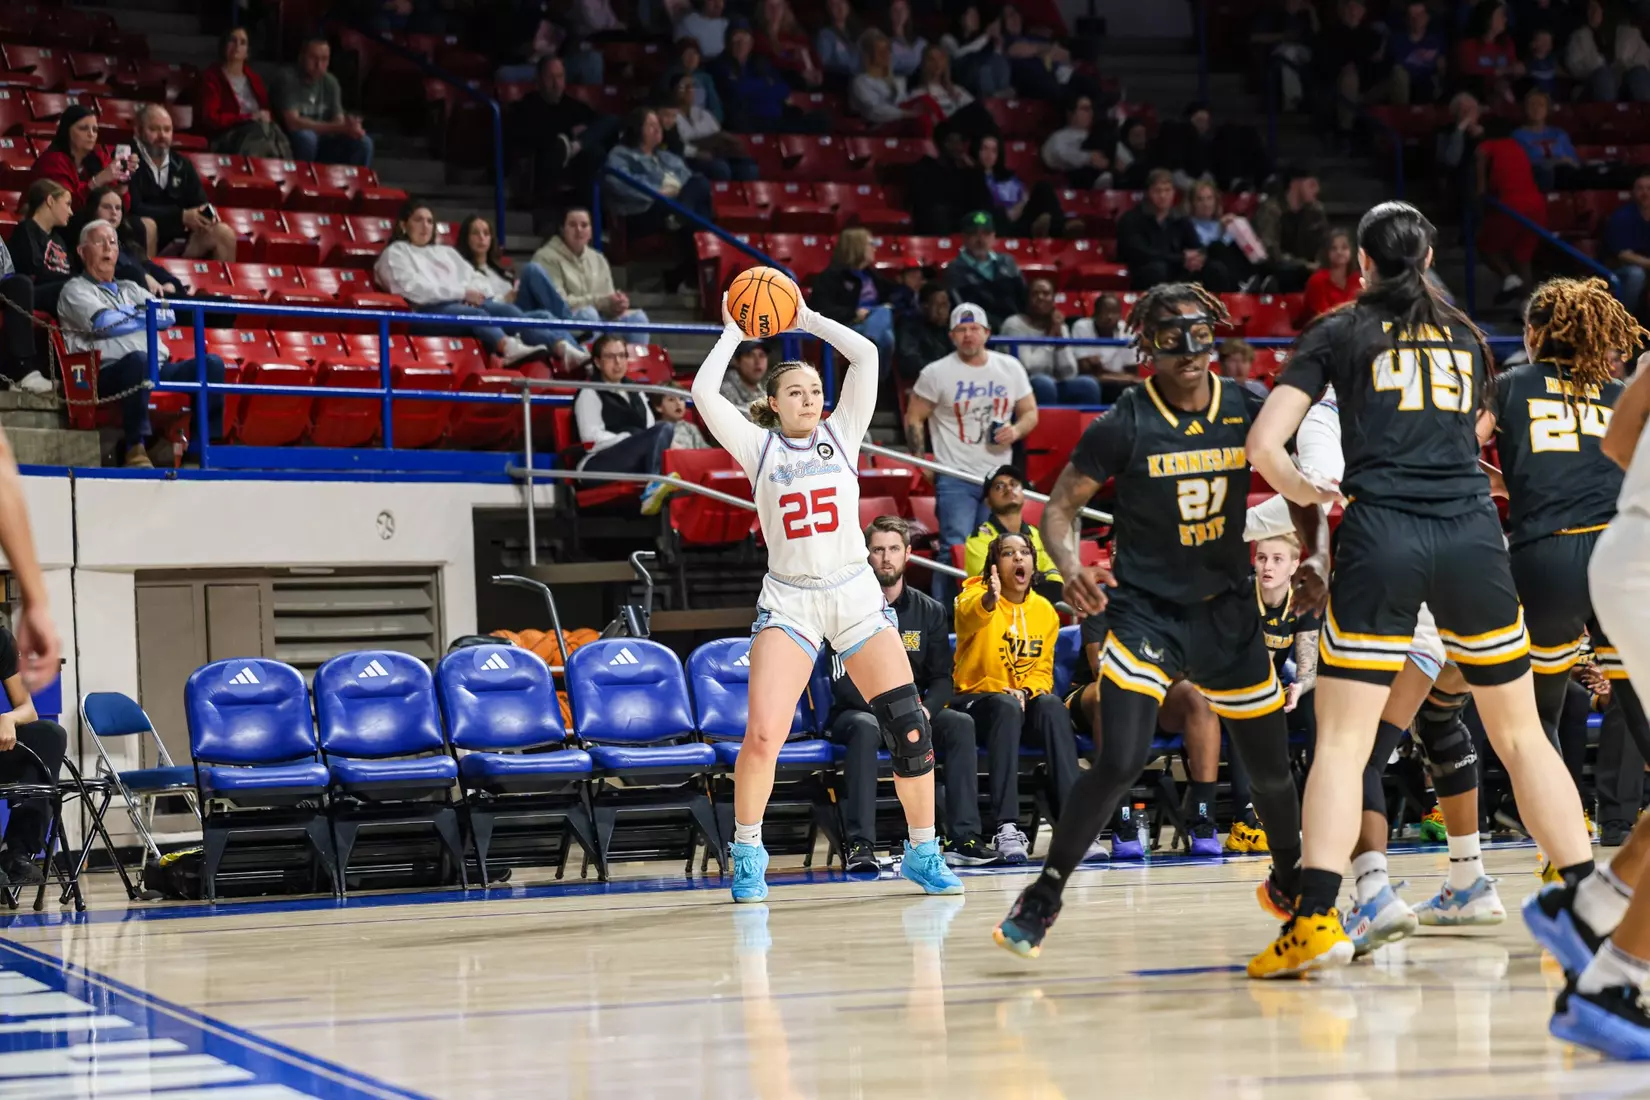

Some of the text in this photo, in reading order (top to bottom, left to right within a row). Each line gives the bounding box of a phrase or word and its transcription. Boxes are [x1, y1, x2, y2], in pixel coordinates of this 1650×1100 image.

[71, 364, 86, 383] T
[954, 380, 1008, 402] Hole
[1371, 348, 1473, 414] 45
[779, 487, 839, 539] 25
[1177, 477, 1228, 520] 21
